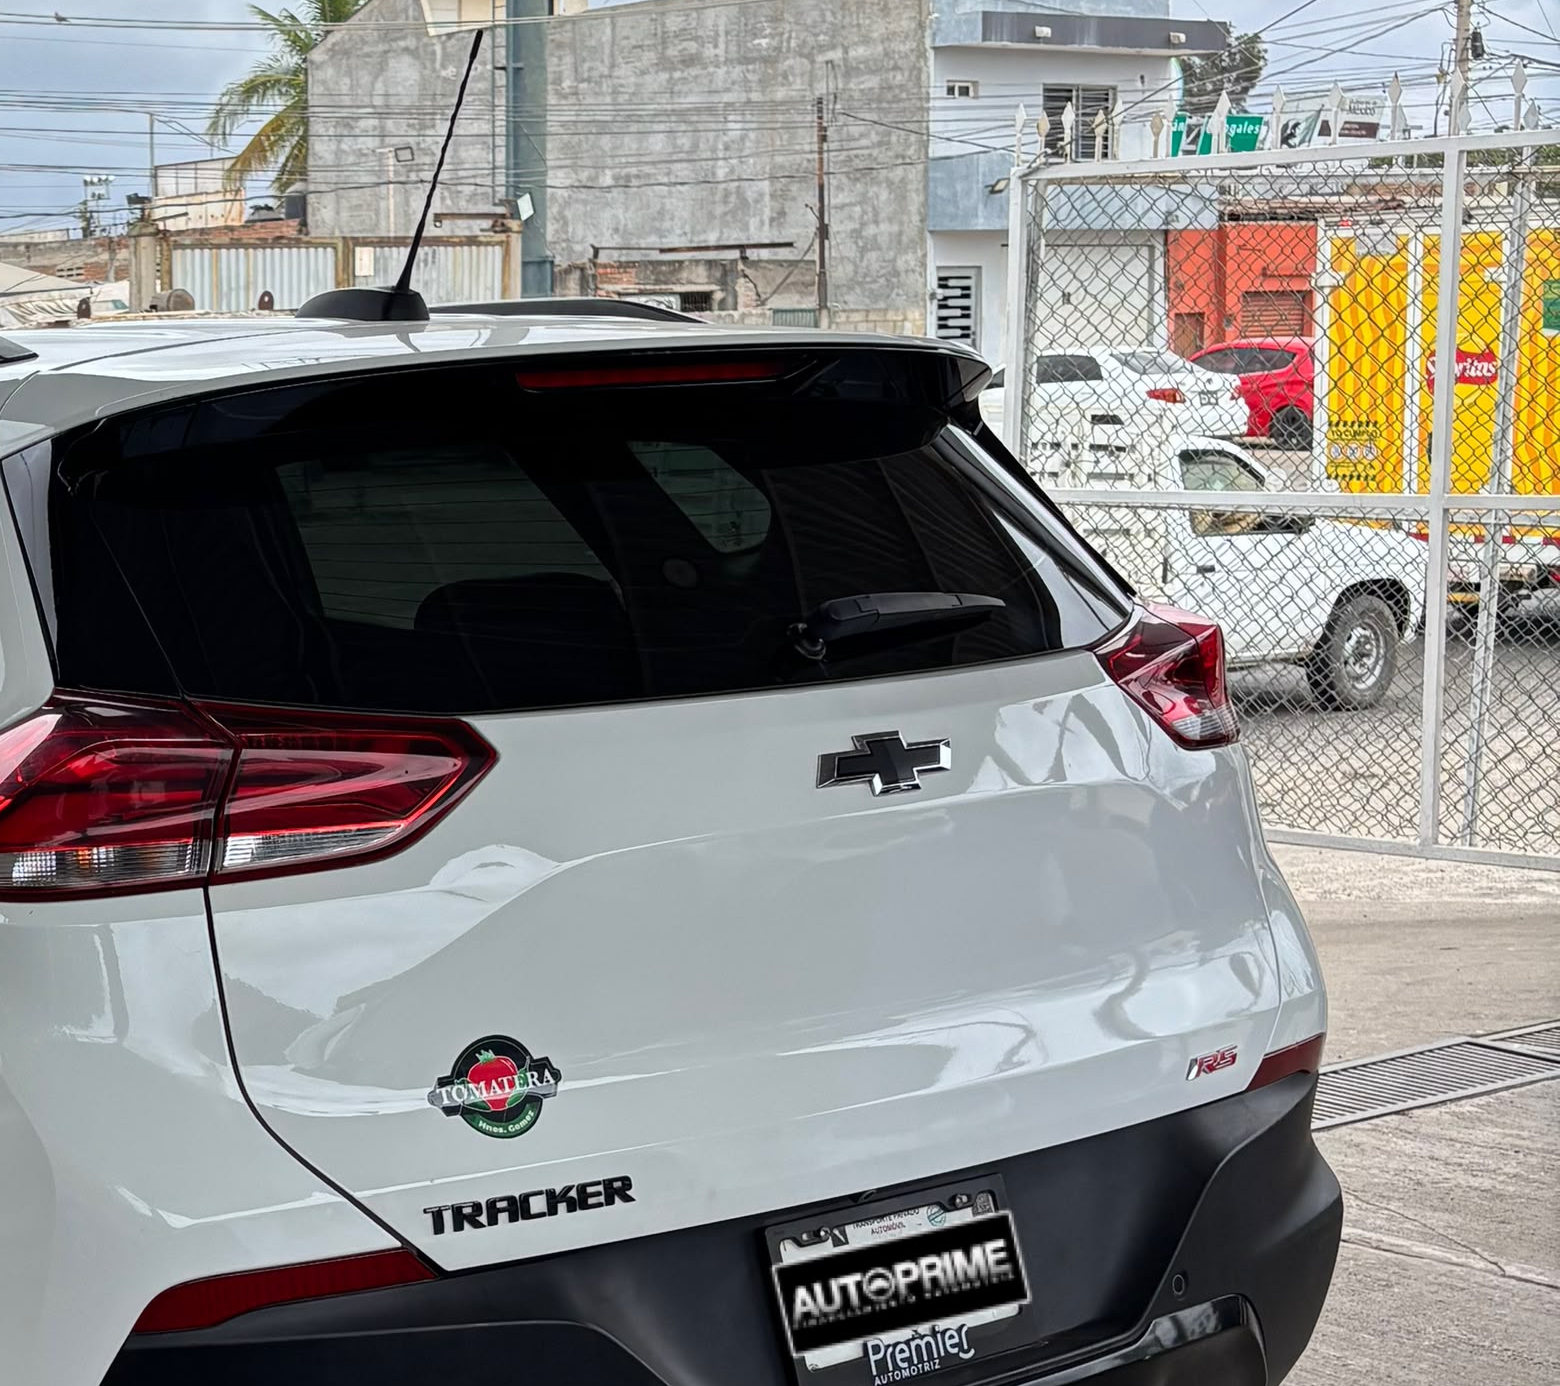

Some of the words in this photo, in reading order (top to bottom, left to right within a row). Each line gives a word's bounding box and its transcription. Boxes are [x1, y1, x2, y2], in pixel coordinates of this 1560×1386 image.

[1187, 1044, 1238, 1080] RS
[436, 1068, 556, 1106] TOMATERA
[477, 1119, 508, 1134] Hnos.
[423, 1175, 637, 1236] TRACKER
[866, 1323, 976, 1377] Premier
[873, 1359, 941, 1386] AUTOMOTRIZ
